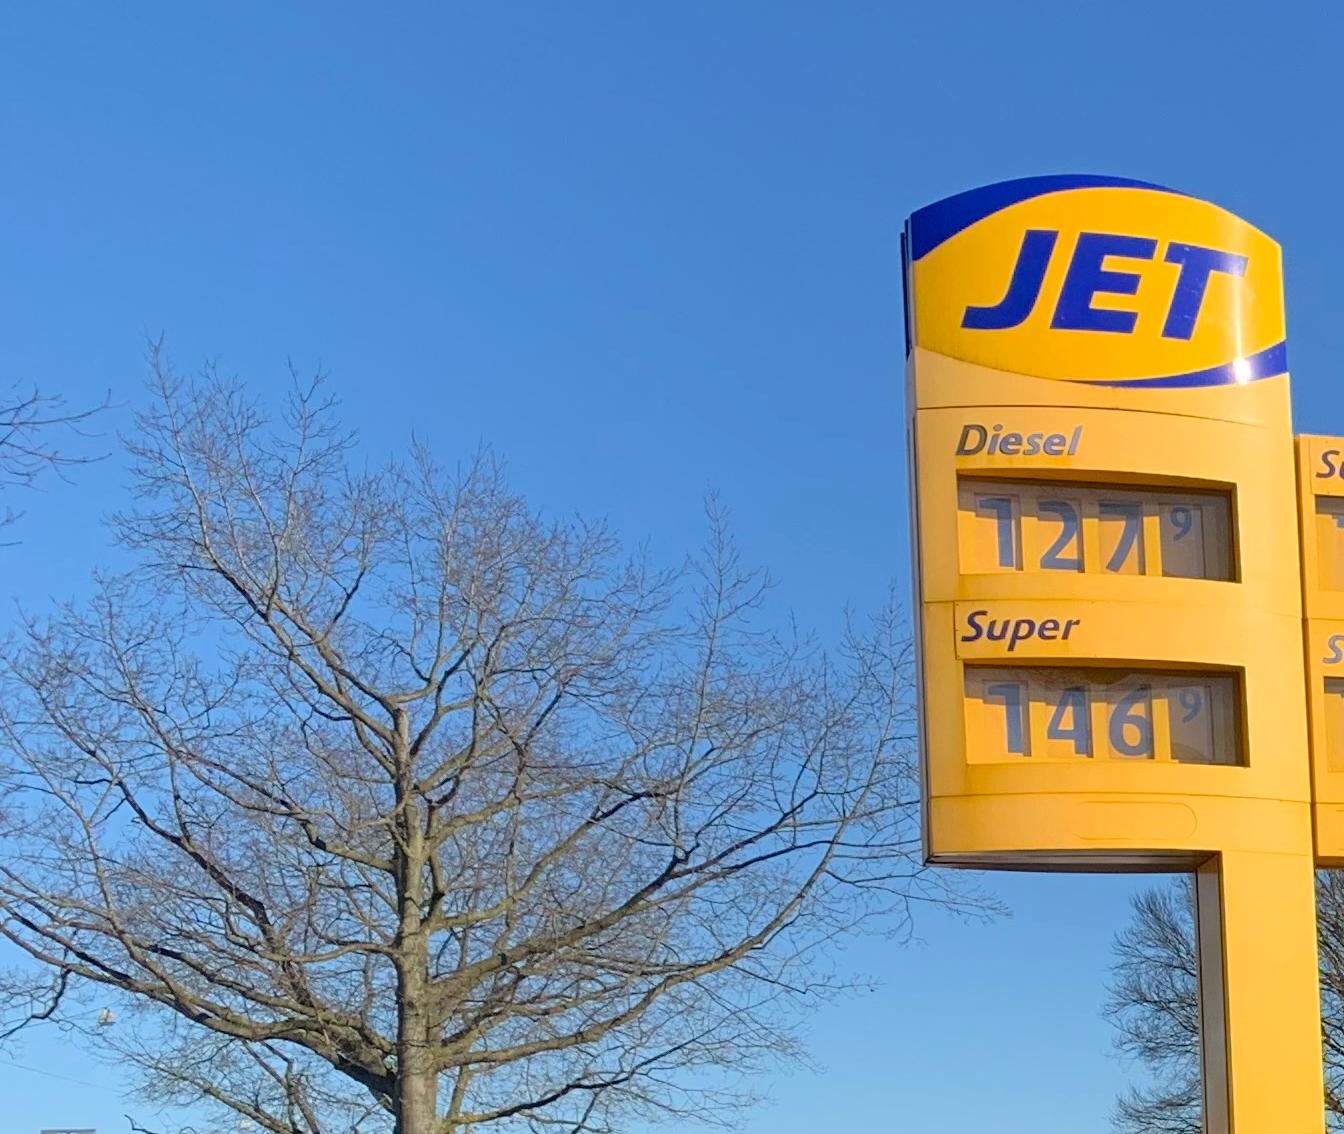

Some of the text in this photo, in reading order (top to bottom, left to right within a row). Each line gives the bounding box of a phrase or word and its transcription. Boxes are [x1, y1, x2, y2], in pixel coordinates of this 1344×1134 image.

[961, 229, 1248, 341] JET
[955, 424, 1083, 456] Diesel
[961, 610, 1081, 651] Super
